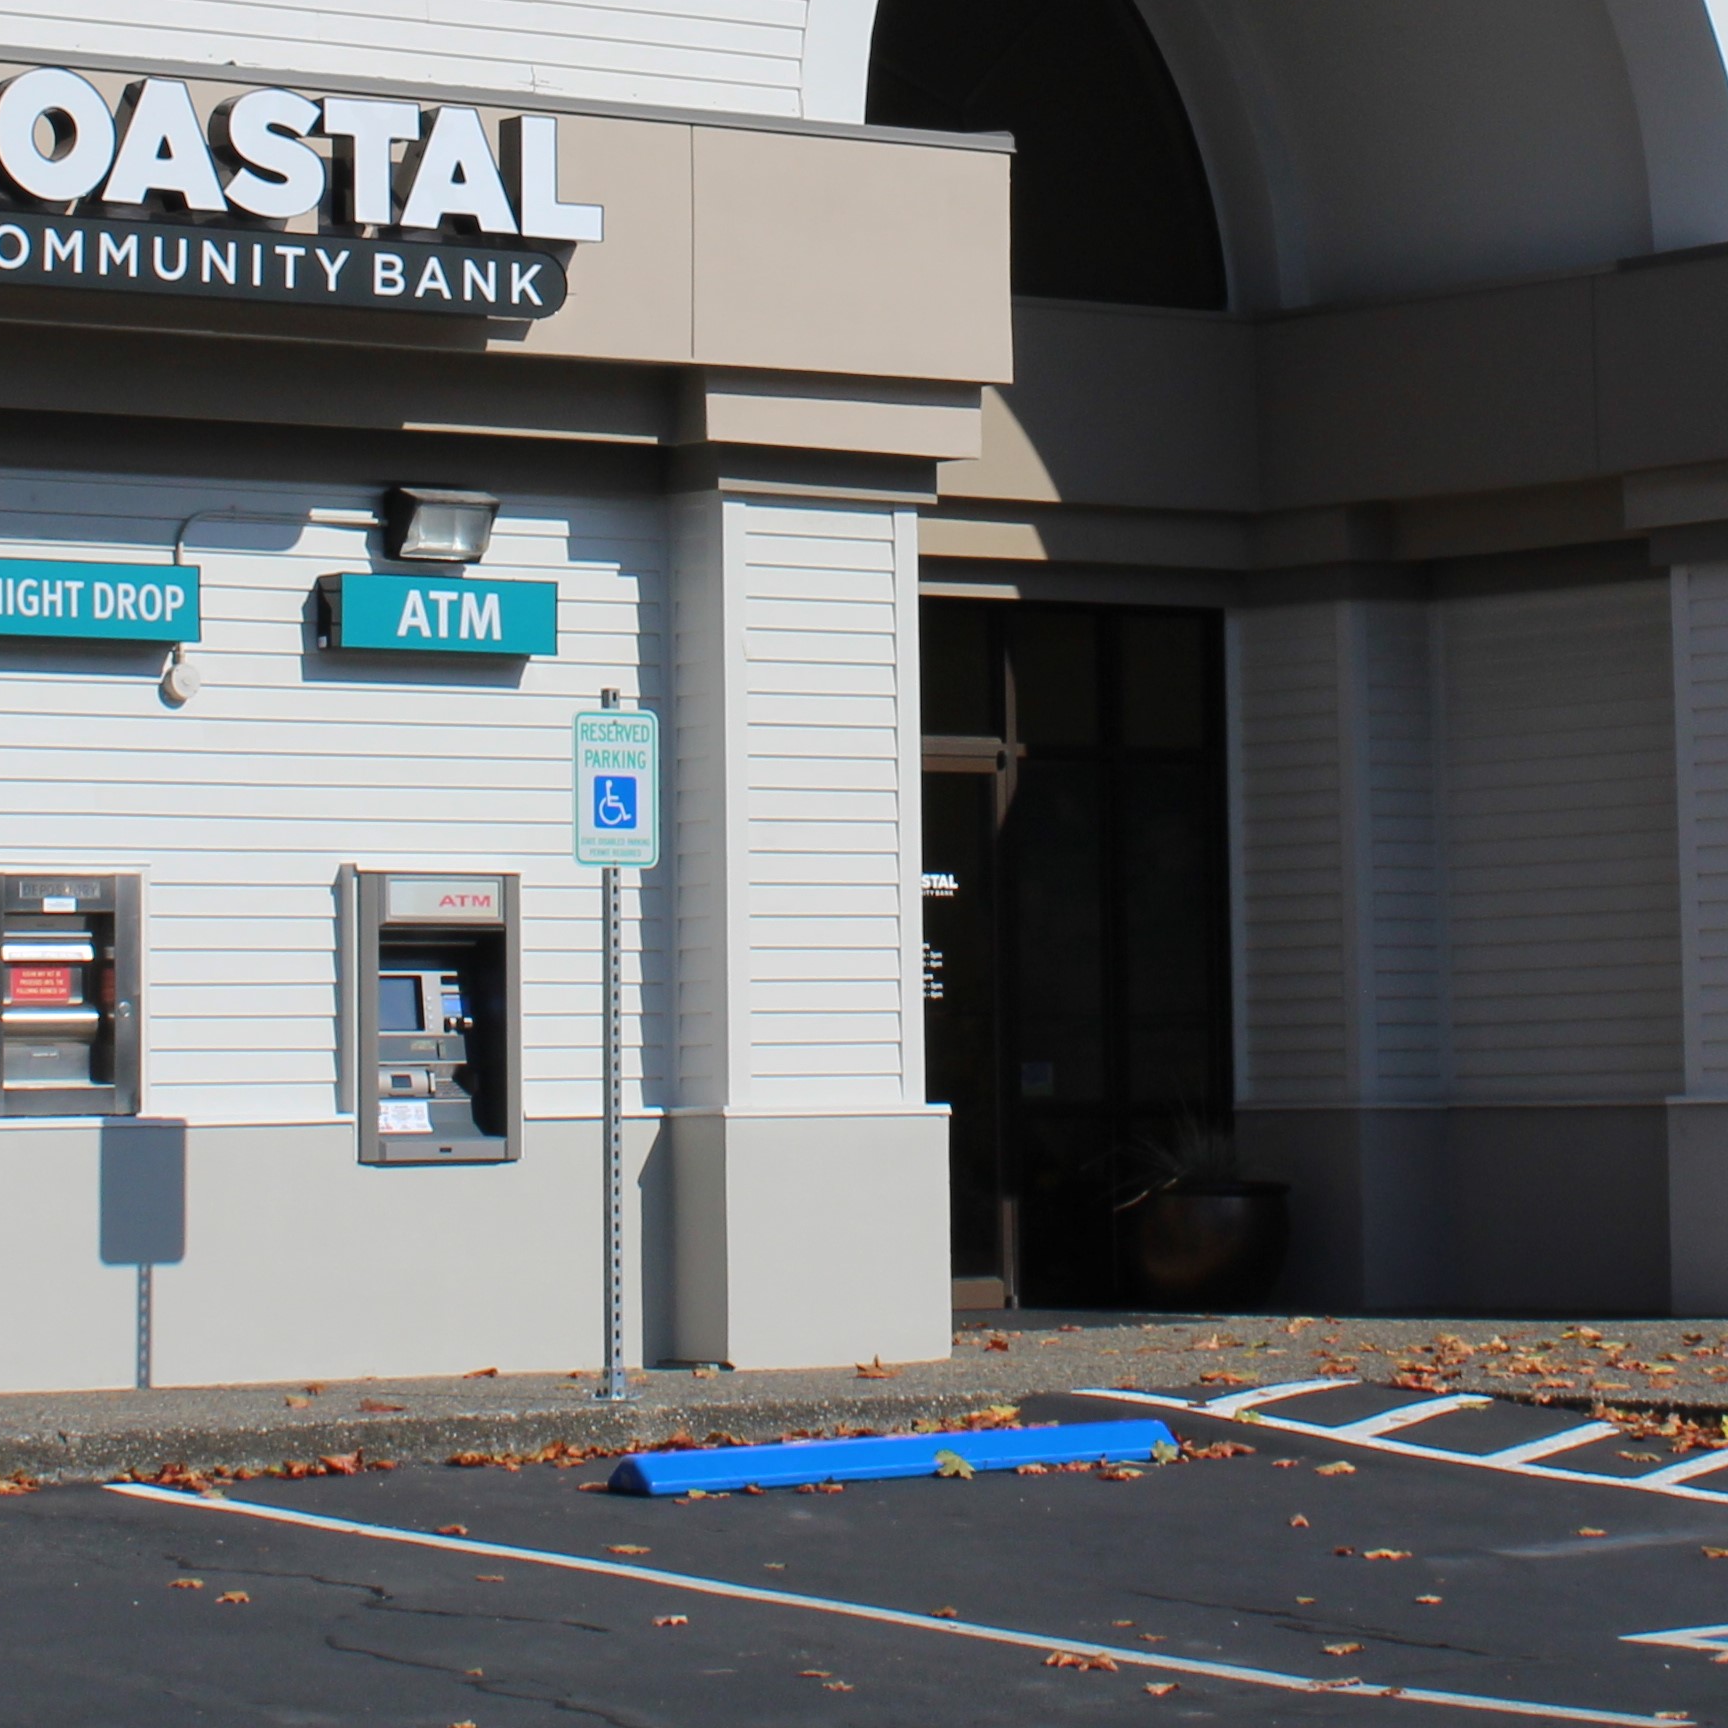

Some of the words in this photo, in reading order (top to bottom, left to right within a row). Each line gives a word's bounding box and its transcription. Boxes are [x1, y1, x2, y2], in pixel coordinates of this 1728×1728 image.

[373, 252, 544, 307] BANK
[92, 581, 185, 622] DROP
[396, 589, 503, 641] ATM
[580, 722, 650, 743] RESERVED
[584, 749, 647, 770] PARKING
[627, 837, 650, 847] PARKING
[589, 847, 610, 857] PERMIT
[23, 882, 99, 897] DEPOSORY
[922, 873, 959, 889] STAL
[438, 894, 491, 907] ATM
